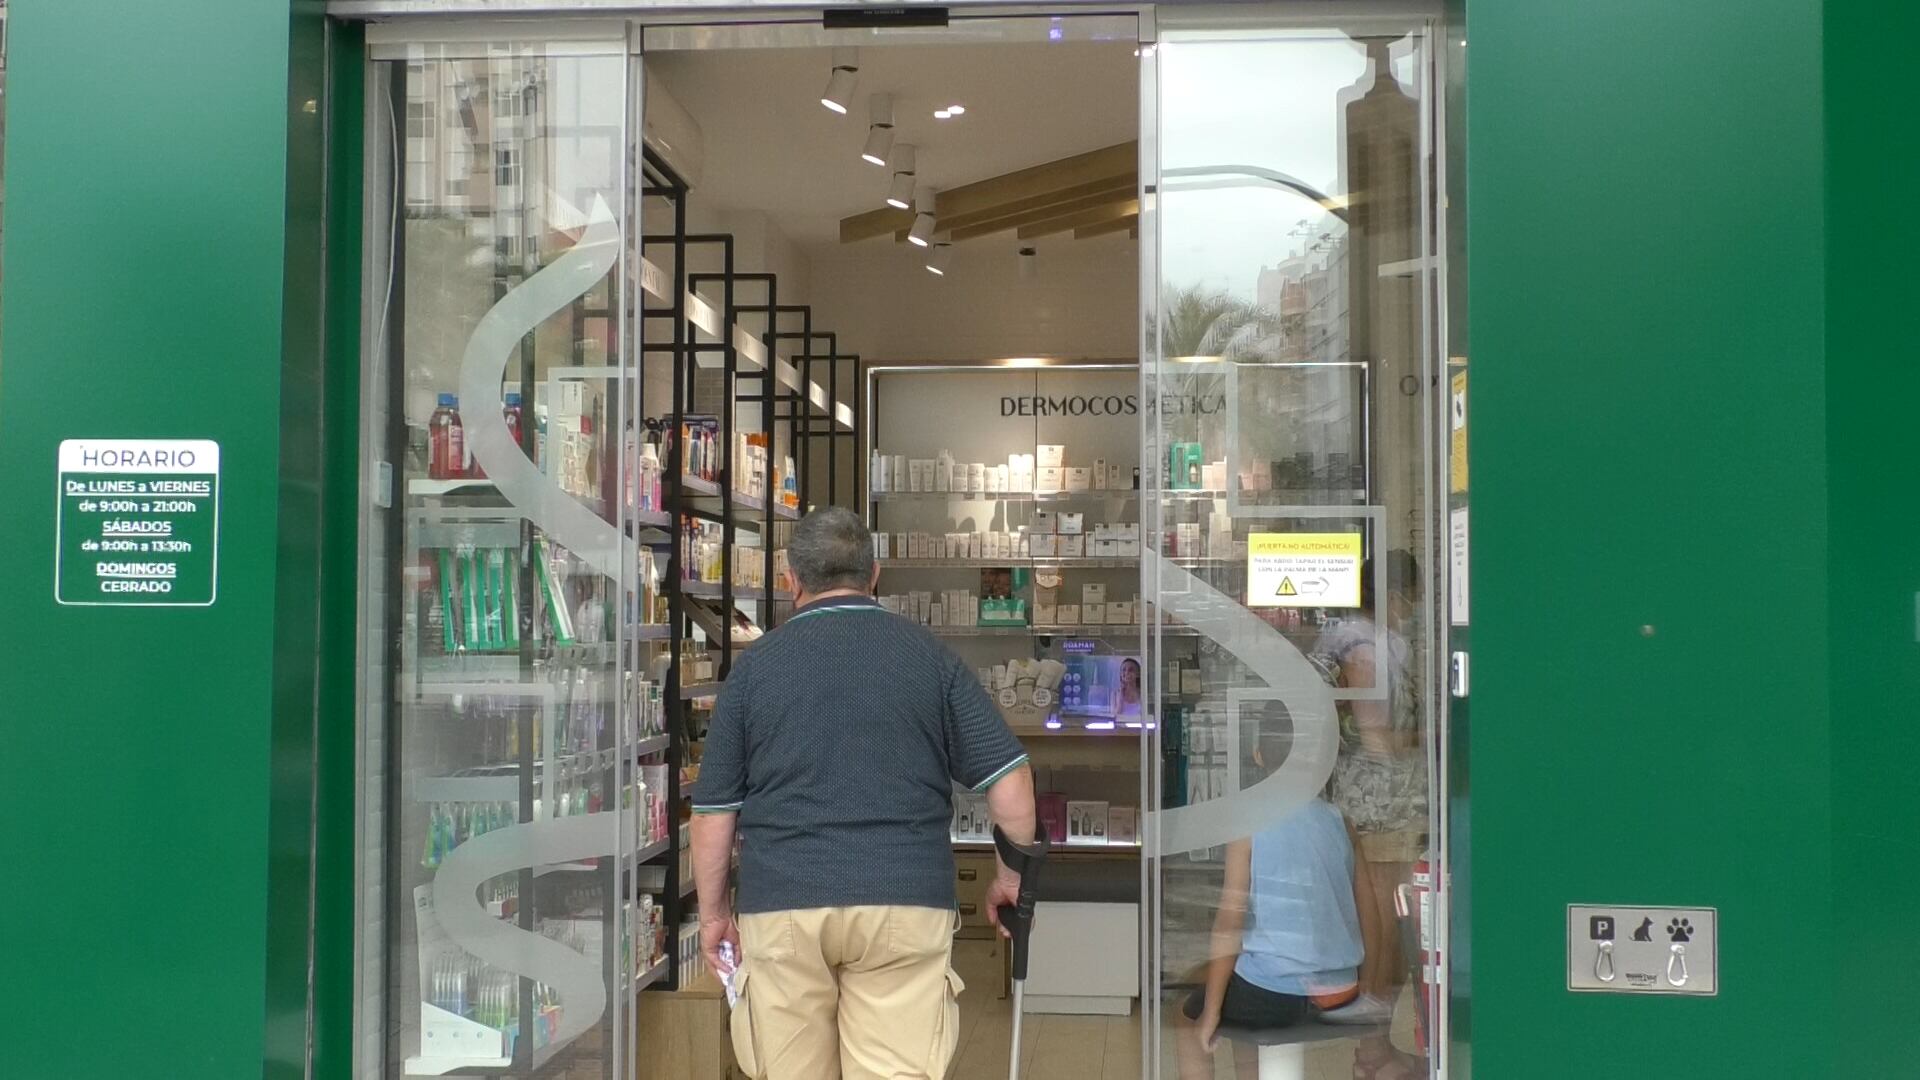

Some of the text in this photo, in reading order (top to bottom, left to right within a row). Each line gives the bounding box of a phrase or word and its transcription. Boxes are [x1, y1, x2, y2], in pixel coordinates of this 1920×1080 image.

[83, 449, 195, 467] HORARIO
[66, 480, 86, 492] De
[89, 480, 136, 493] LUNES
[149, 480, 210, 493] VIERNES
[79, 500, 196, 513] de 9:00h a 21:00h
[102, 517, 172, 533] SÁBADOS
[81, 540, 191, 552] de 9:00h a 13:30h
[96, 563, 177, 575] DOMINGOS
[101, 581, 171, 593] CERRADO
